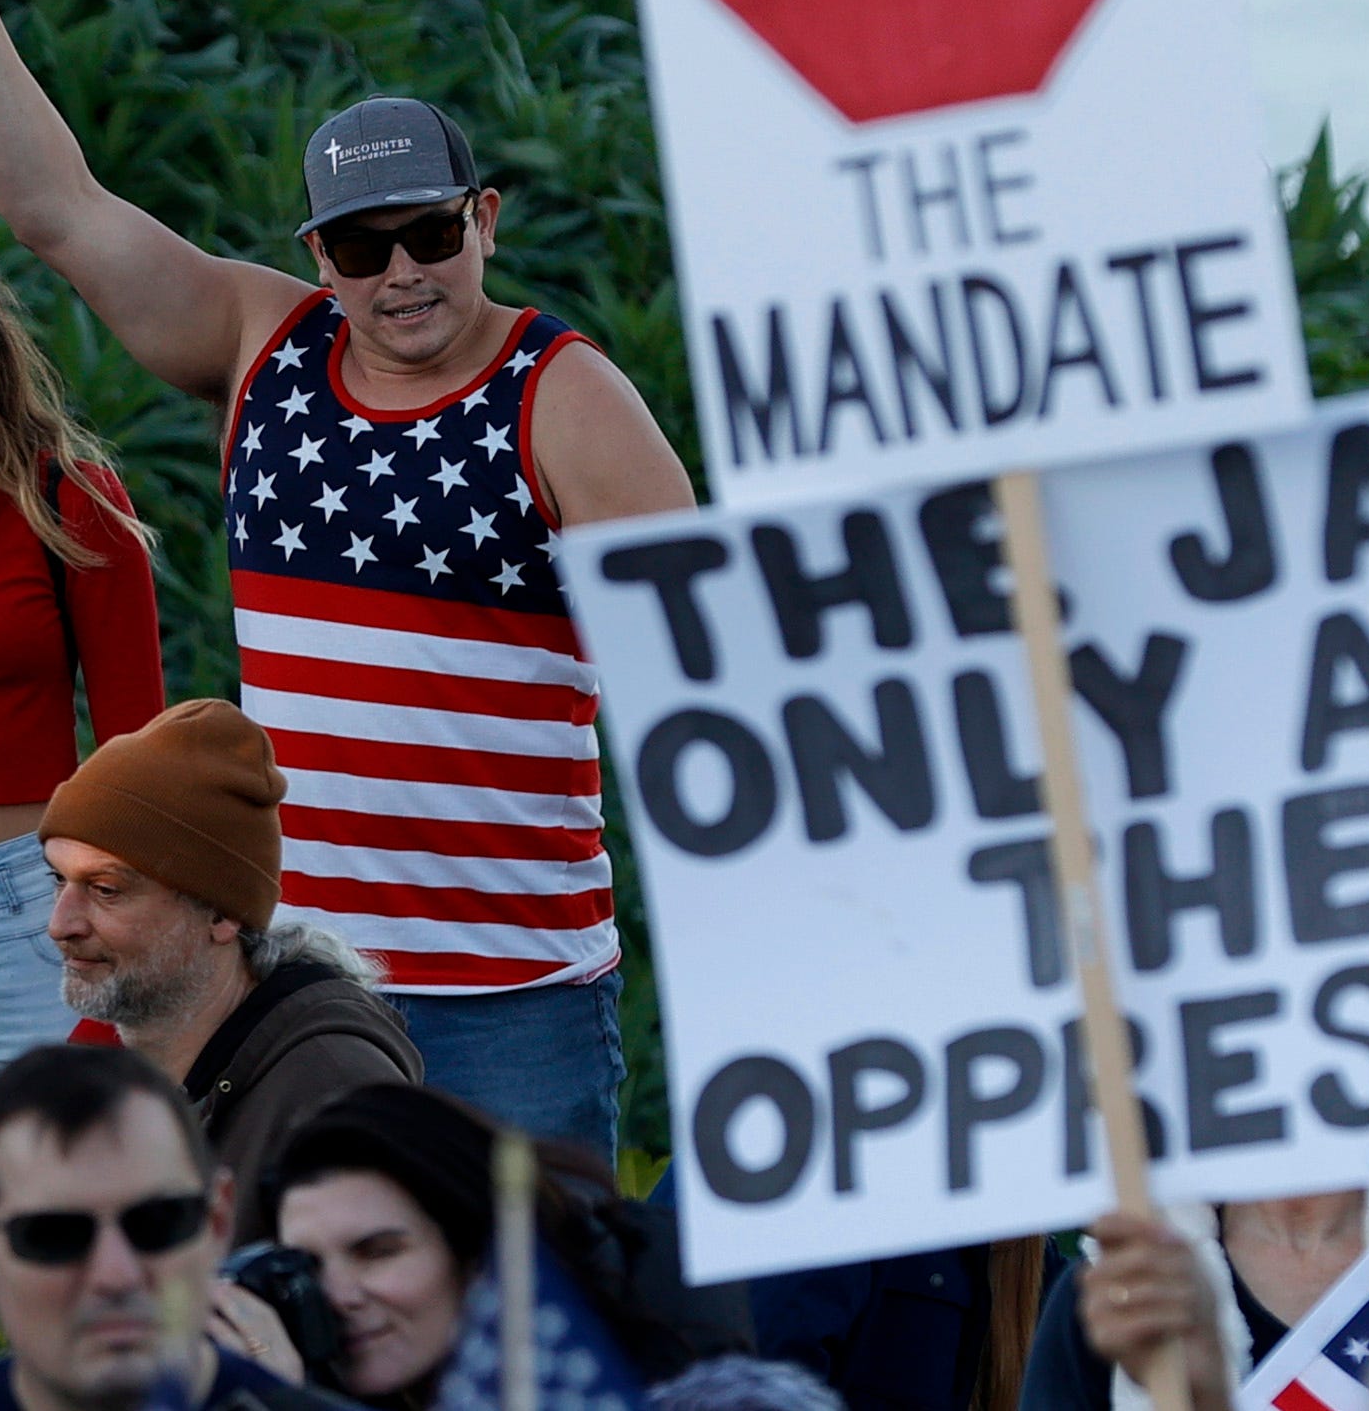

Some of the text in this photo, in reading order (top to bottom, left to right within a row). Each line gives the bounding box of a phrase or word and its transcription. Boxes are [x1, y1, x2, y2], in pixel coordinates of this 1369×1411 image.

[339, 138, 413, 160] ENCOUNTER
[833, 129, 1042, 263] THE
[708, 232, 1266, 470] MANDATE
[600, 477, 1071, 684] THE
[635, 631, 1190, 857] ONLY
